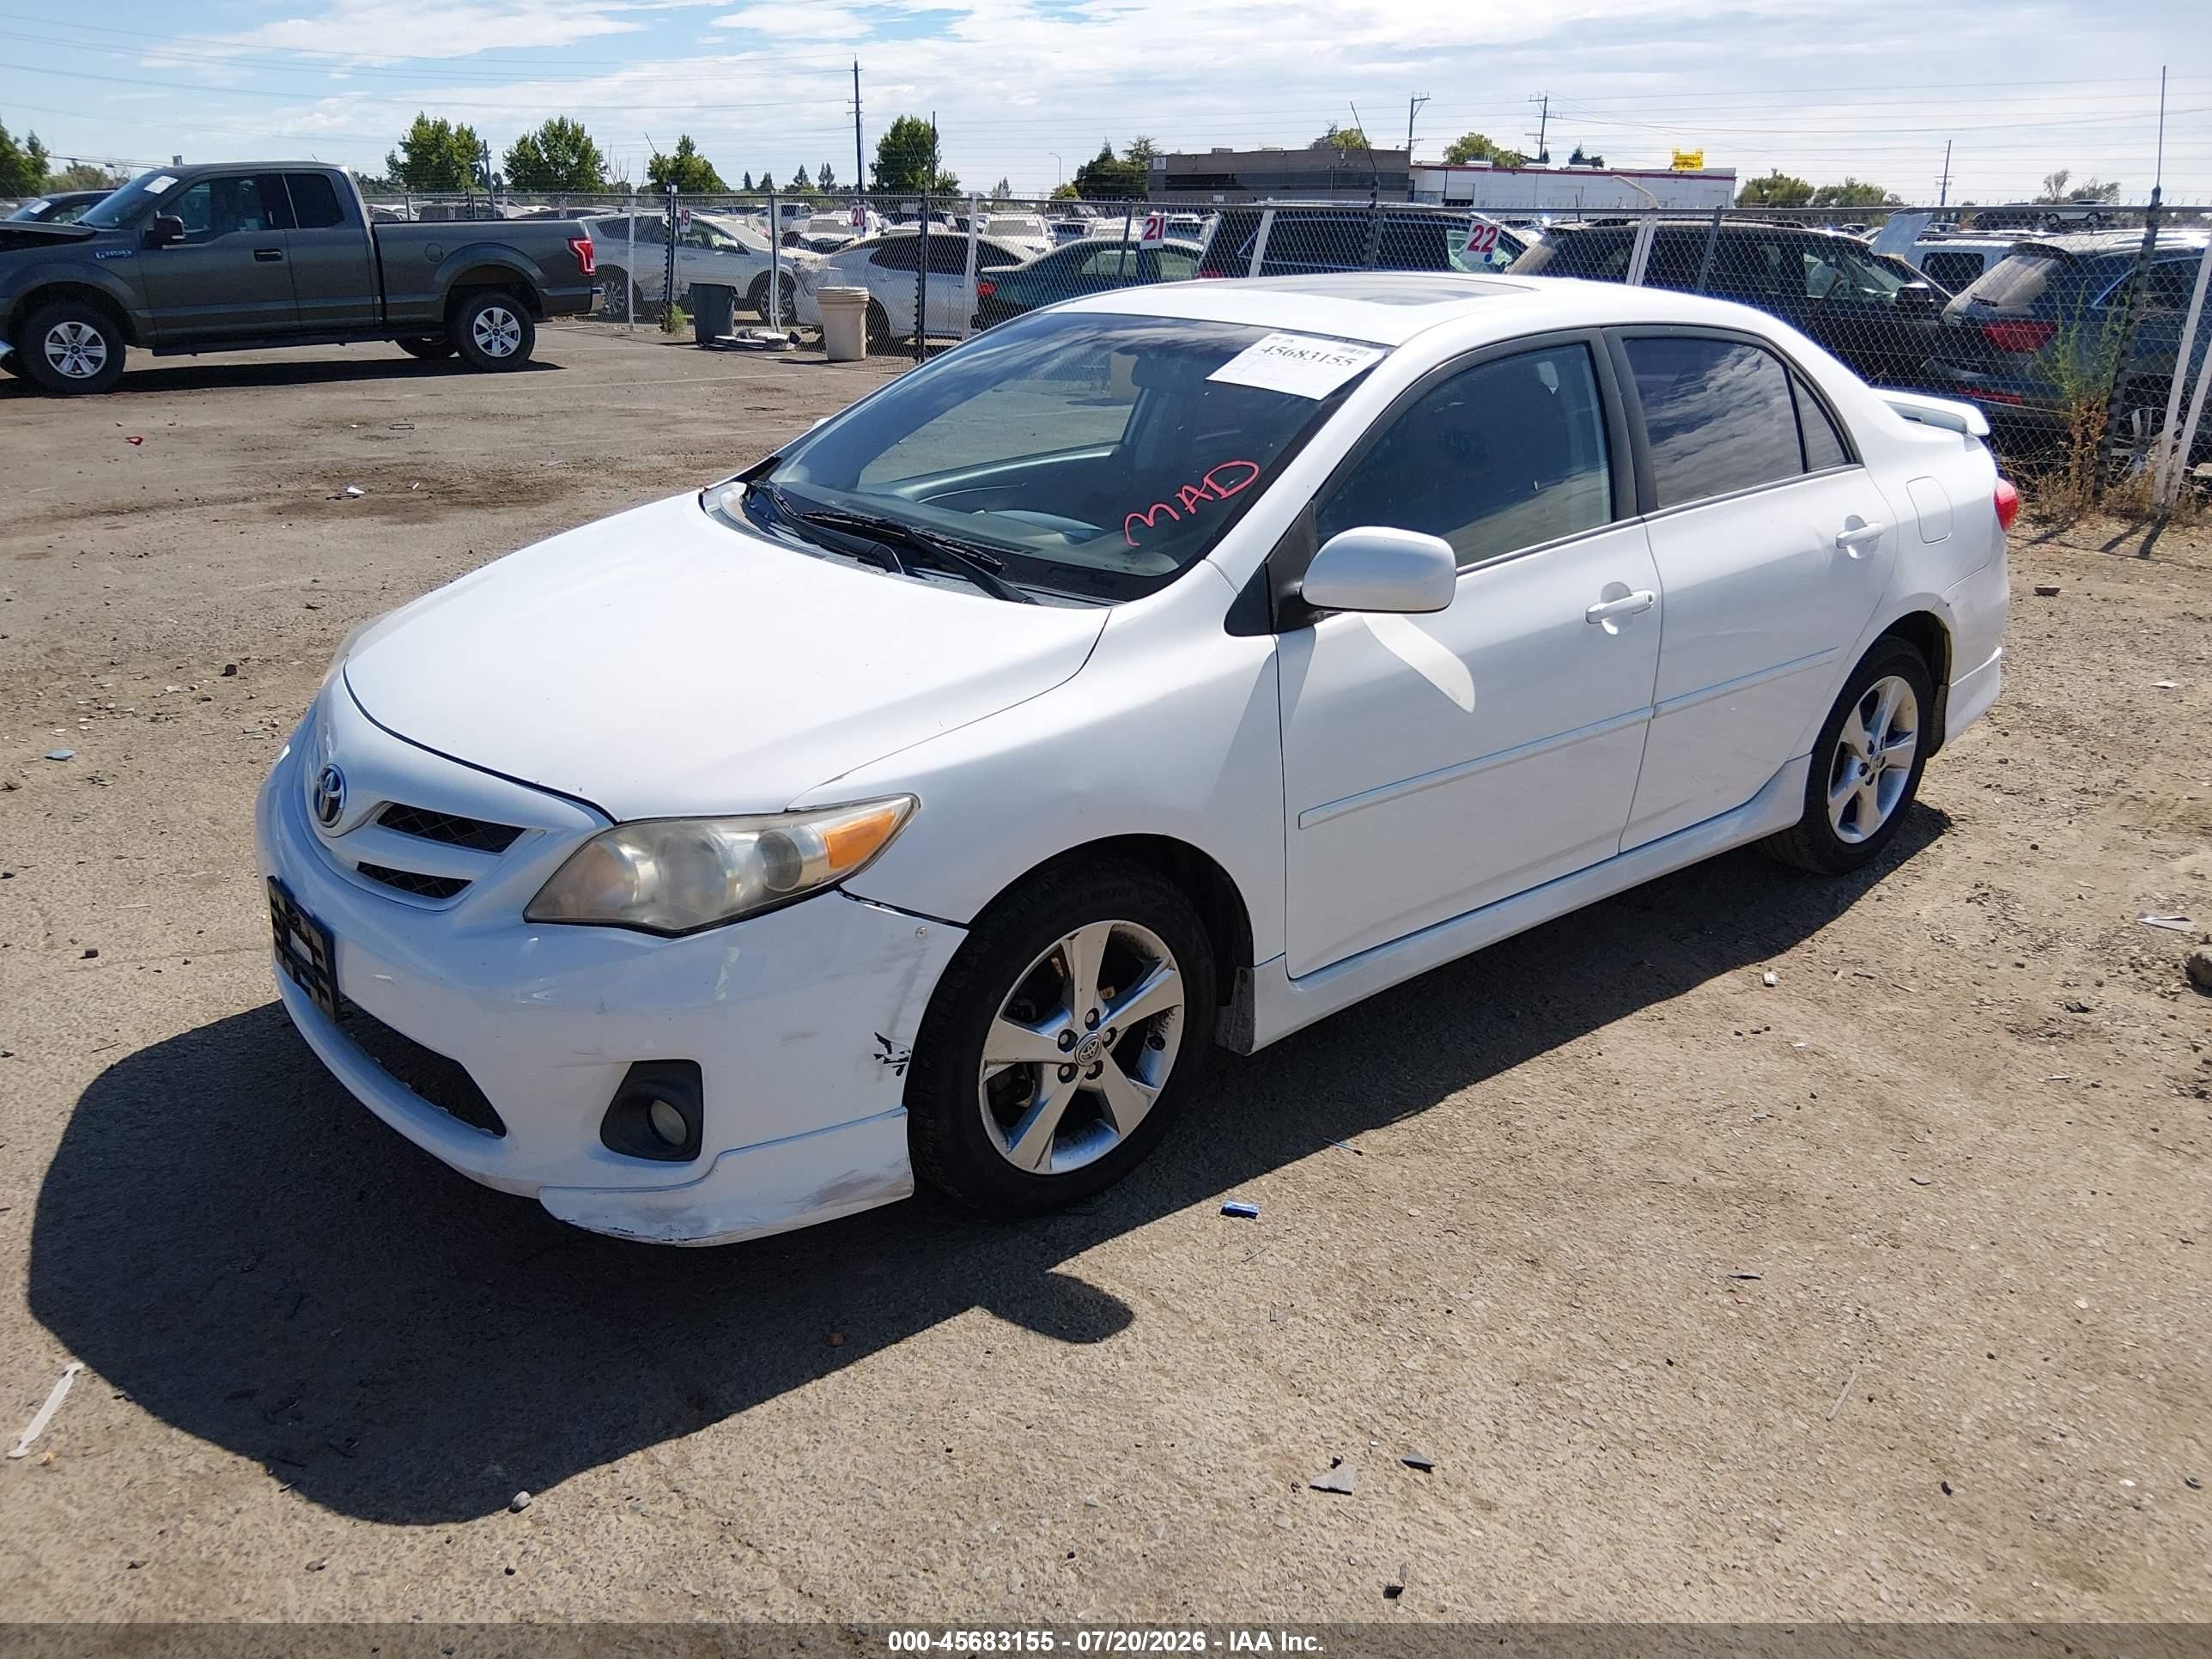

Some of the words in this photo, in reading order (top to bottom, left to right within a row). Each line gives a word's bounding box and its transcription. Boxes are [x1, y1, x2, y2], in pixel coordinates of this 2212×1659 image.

[681, 210, 690, 226] 19
[853, 207, 866, 227] 20
[1144, 218, 1164, 240] 21
[1468, 224, 1498, 252] 22
[1261, 345, 1358, 366] 45683155
[1124, 460, 1260, 547] MAD
